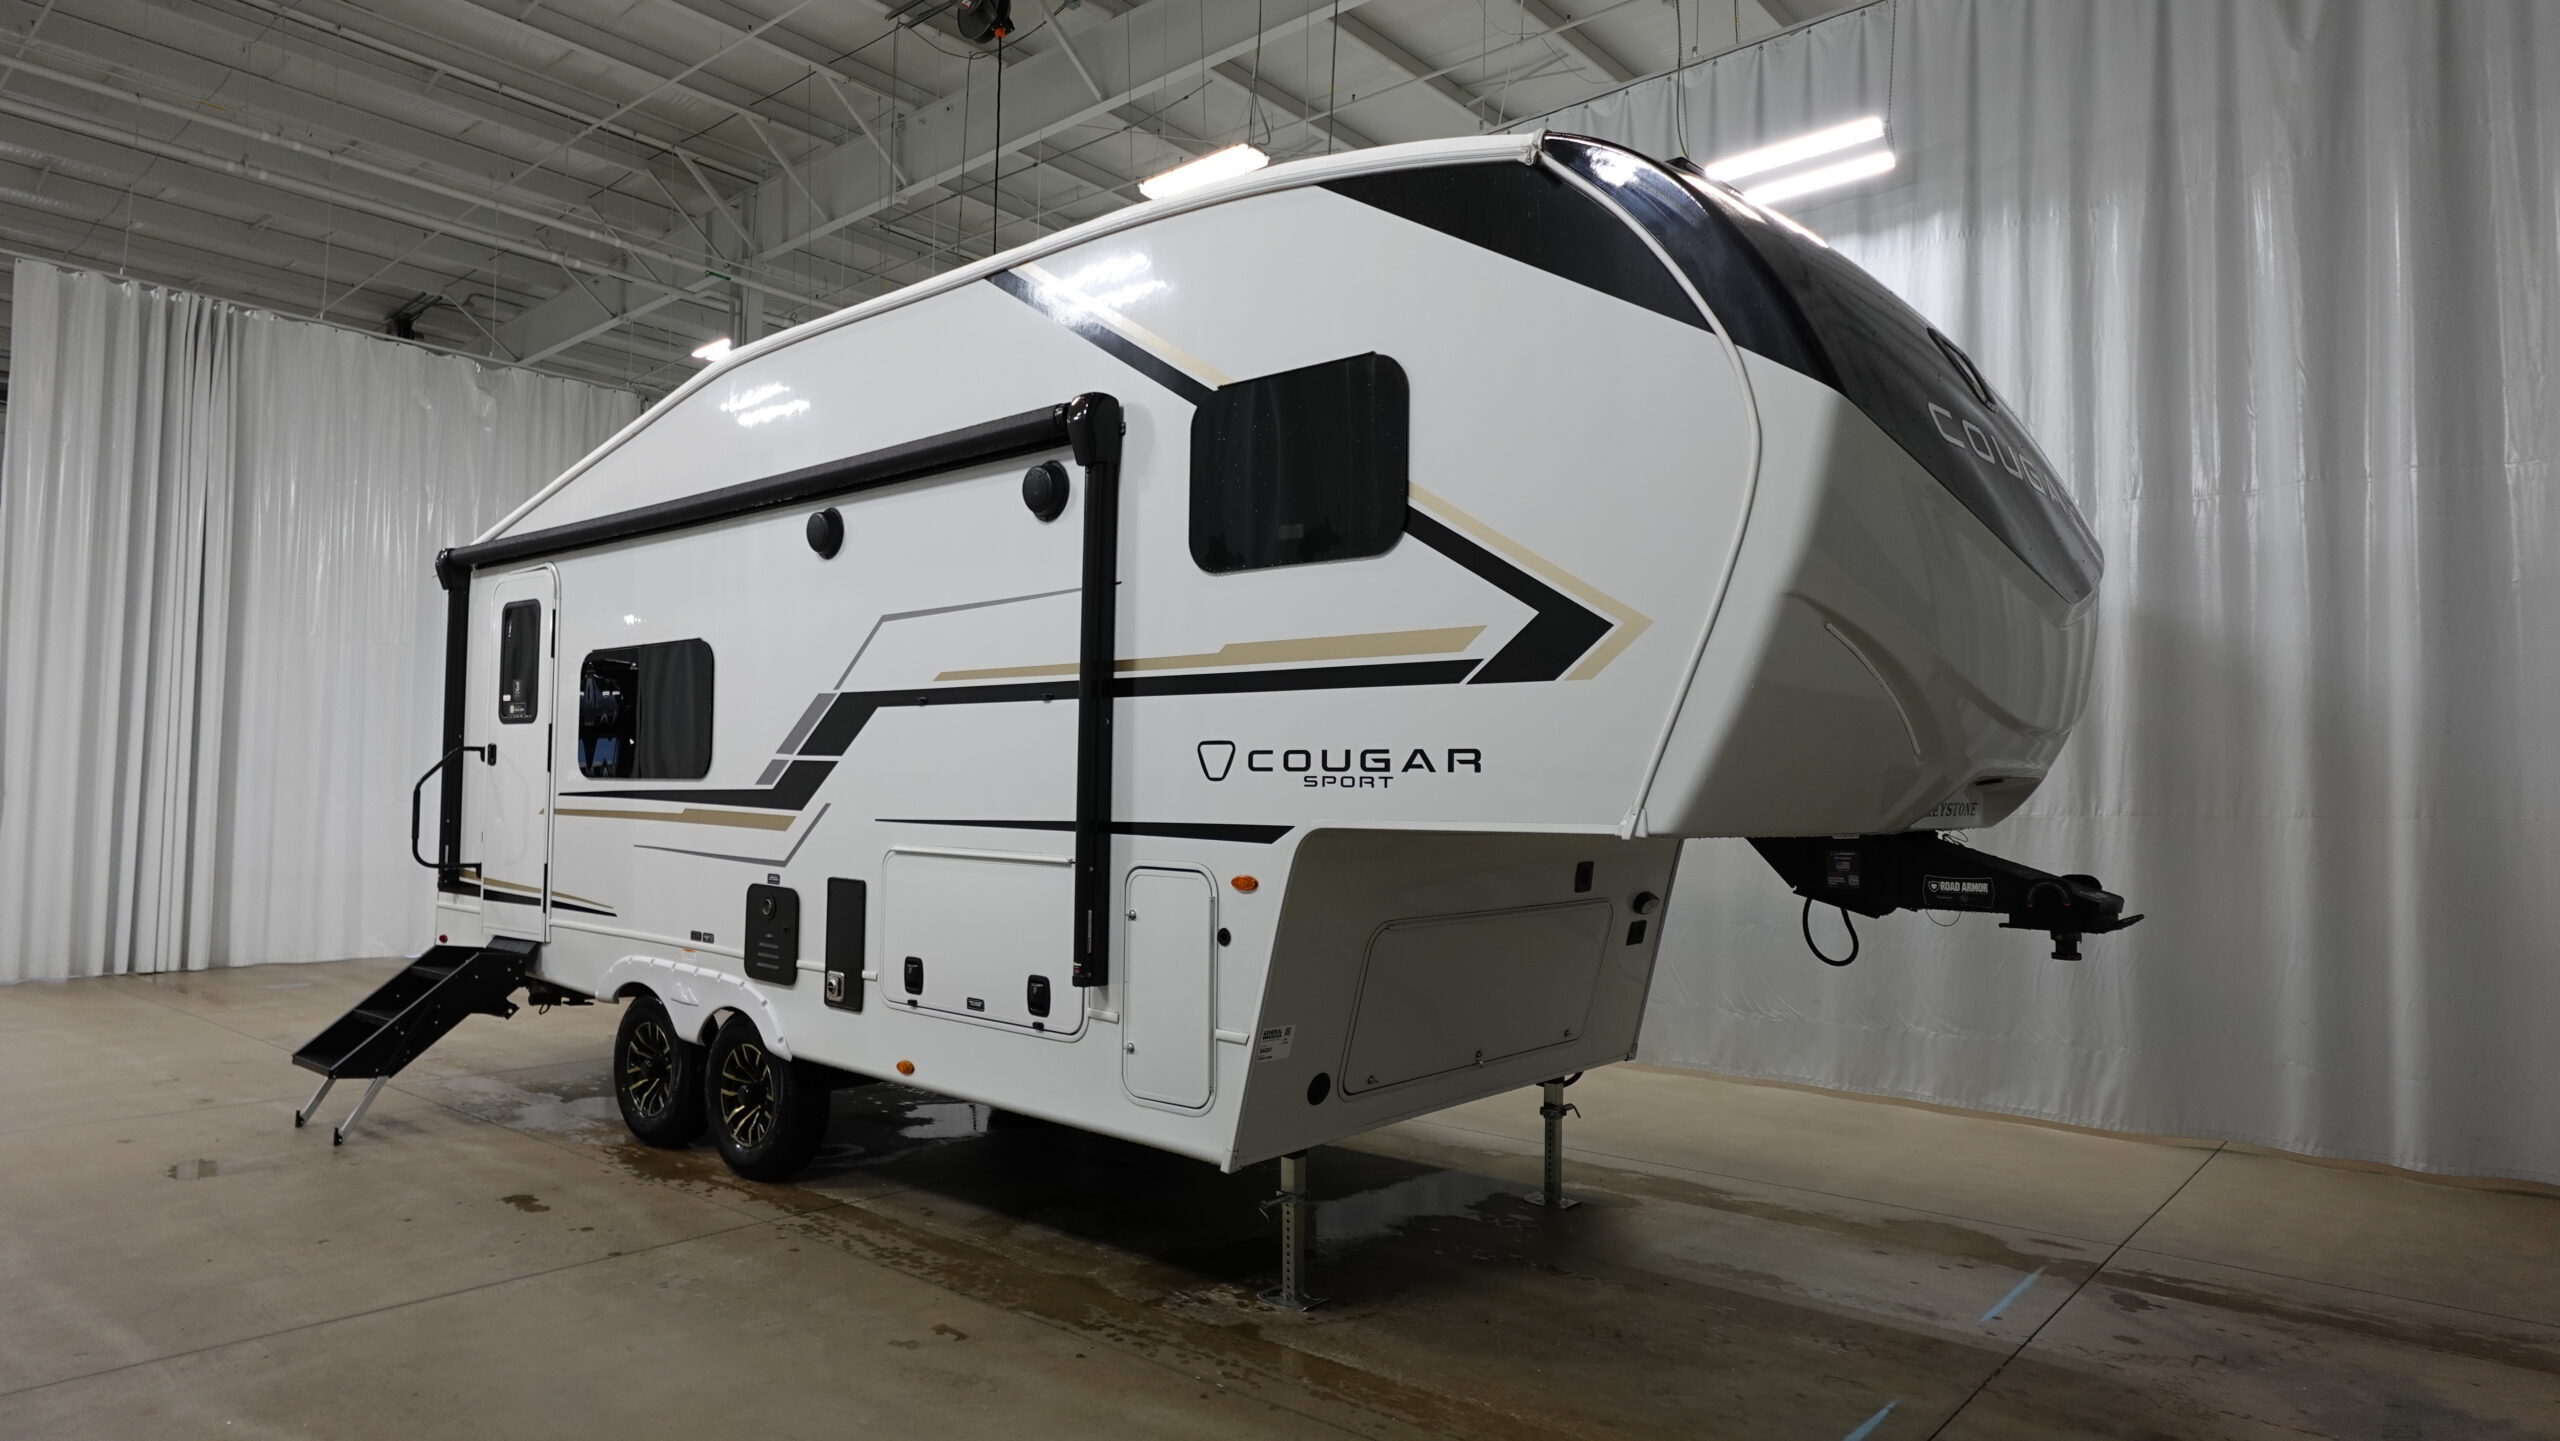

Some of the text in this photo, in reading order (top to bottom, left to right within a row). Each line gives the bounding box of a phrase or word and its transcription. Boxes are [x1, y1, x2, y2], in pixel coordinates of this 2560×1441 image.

[1247, 748, 1482, 773] COUGAR
[1303, 775, 1394, 789] SPORT
[1940, 881, 1989, 894] ROAD ARMOR
